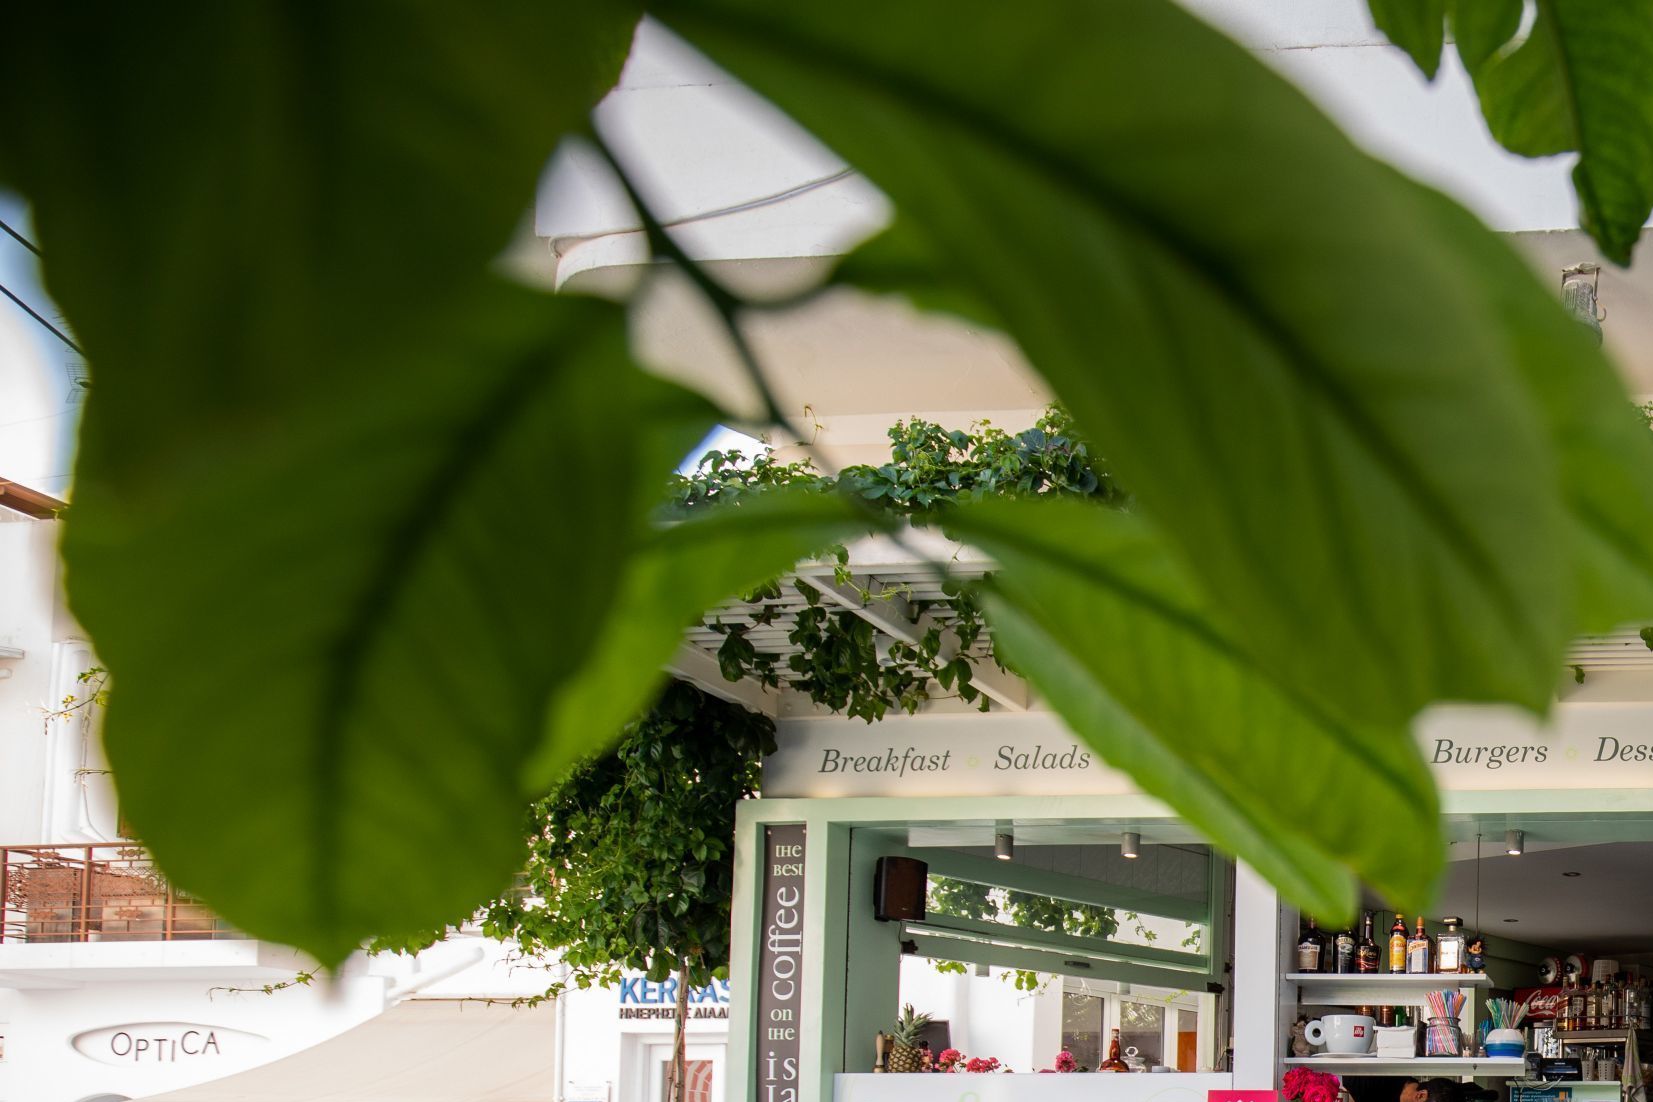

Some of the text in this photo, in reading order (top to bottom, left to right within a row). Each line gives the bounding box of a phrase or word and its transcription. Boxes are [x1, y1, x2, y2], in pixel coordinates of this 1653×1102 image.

[818, 747, 951, 777] Breakfast
[994, 744, 1091, 770] Salads
[1430, 738, 1548, 769] Burgers
[768, 886, 802, 1000] coffee
[770, 1008, 792, 1021] on
